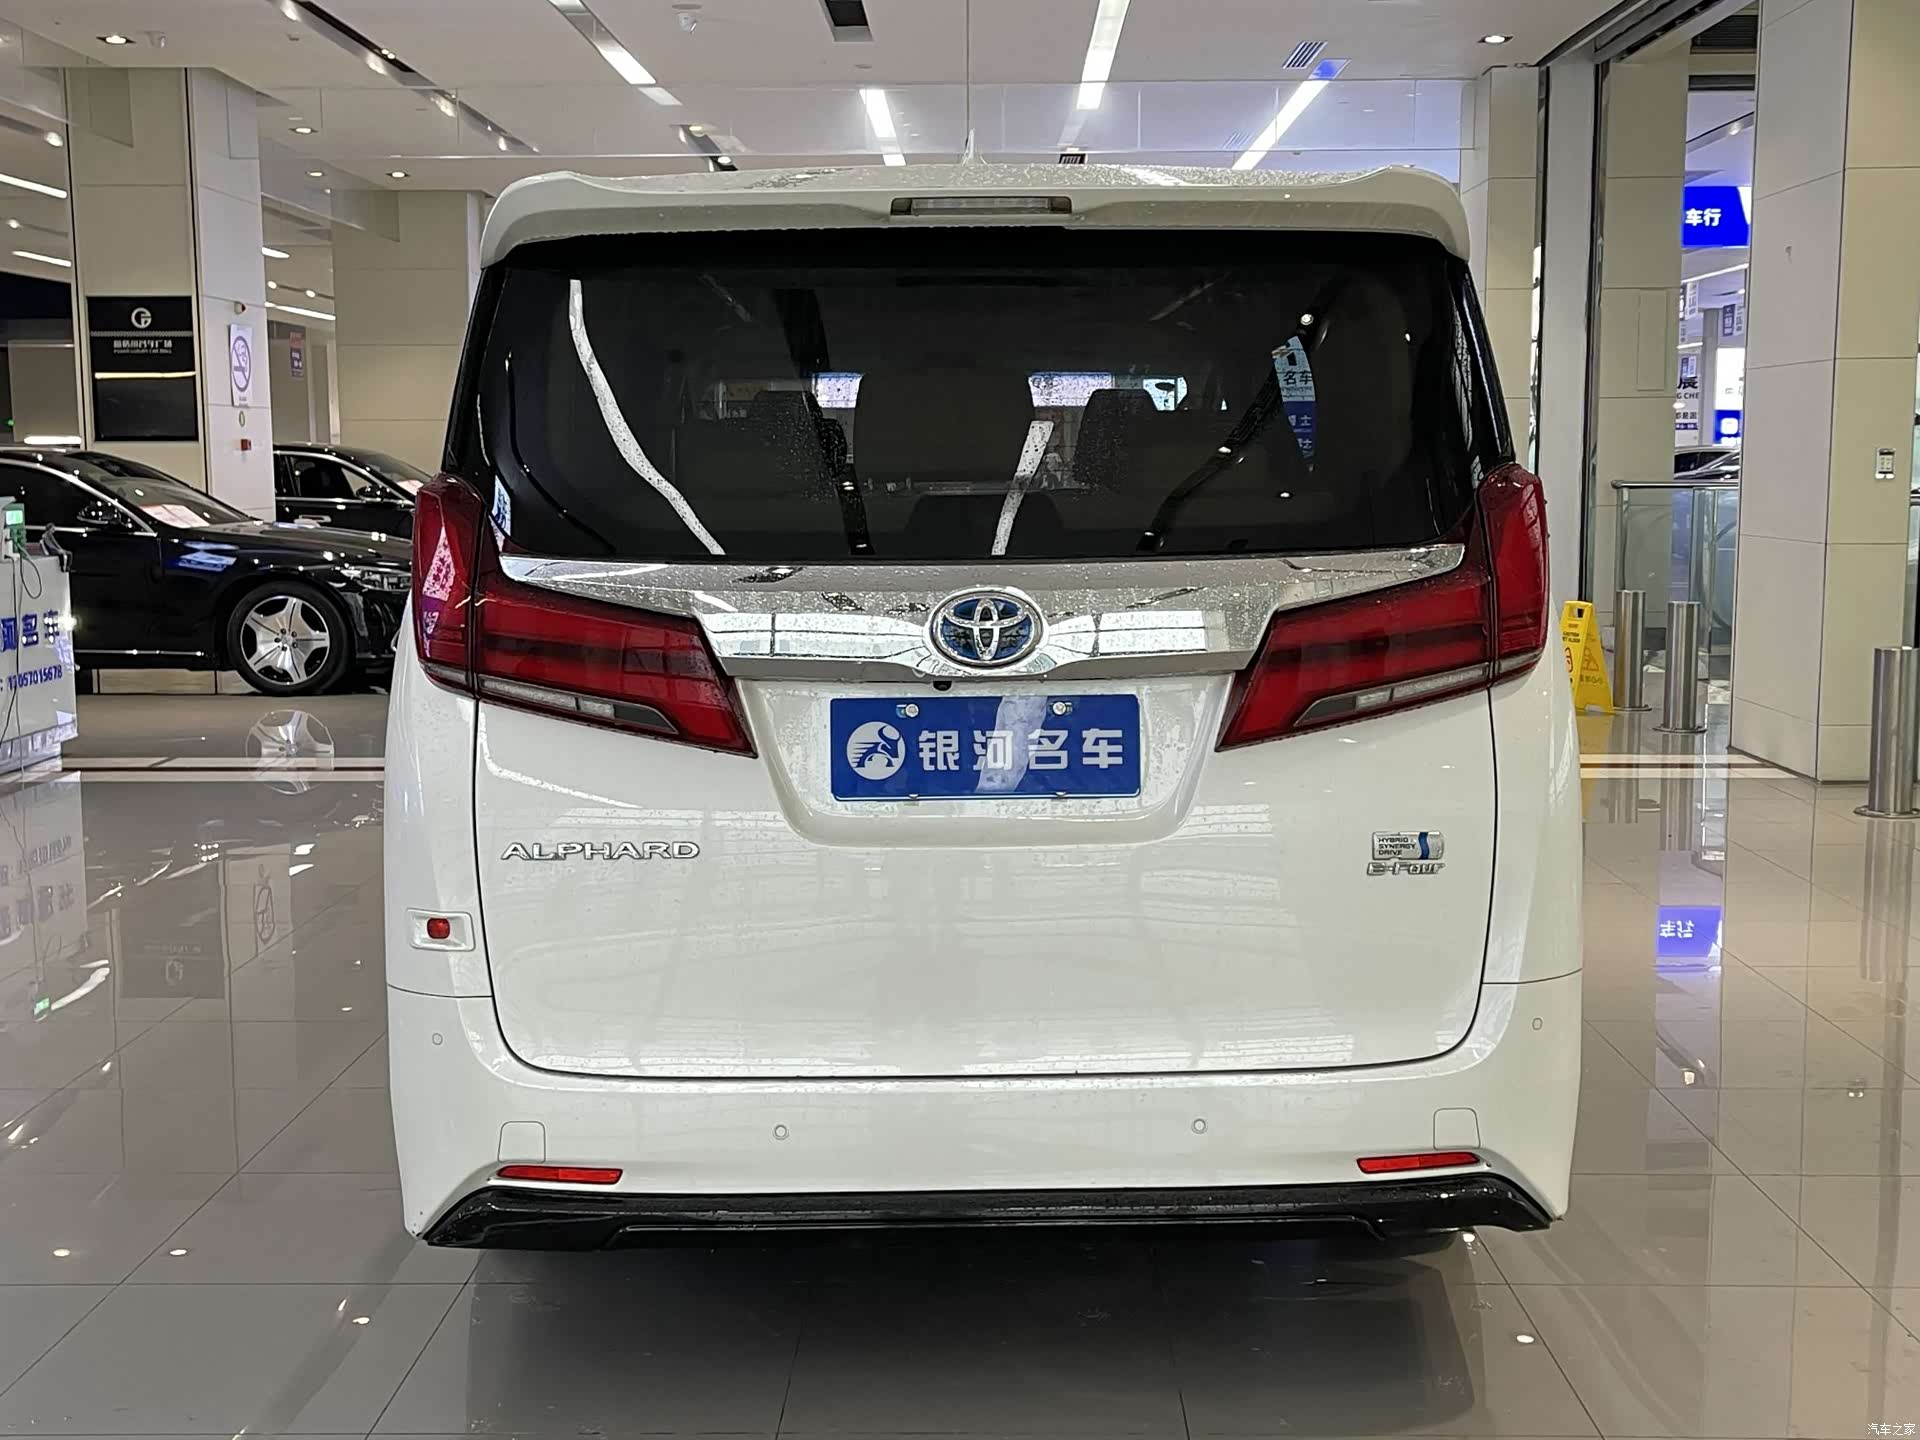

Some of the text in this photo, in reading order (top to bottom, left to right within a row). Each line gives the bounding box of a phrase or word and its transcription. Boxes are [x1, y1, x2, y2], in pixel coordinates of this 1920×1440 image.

[1685, 208, 1722, 227] 车行
[918, 728, 1123, 771] 银河名车
[500, 841, 700, 860] ALPHARD
